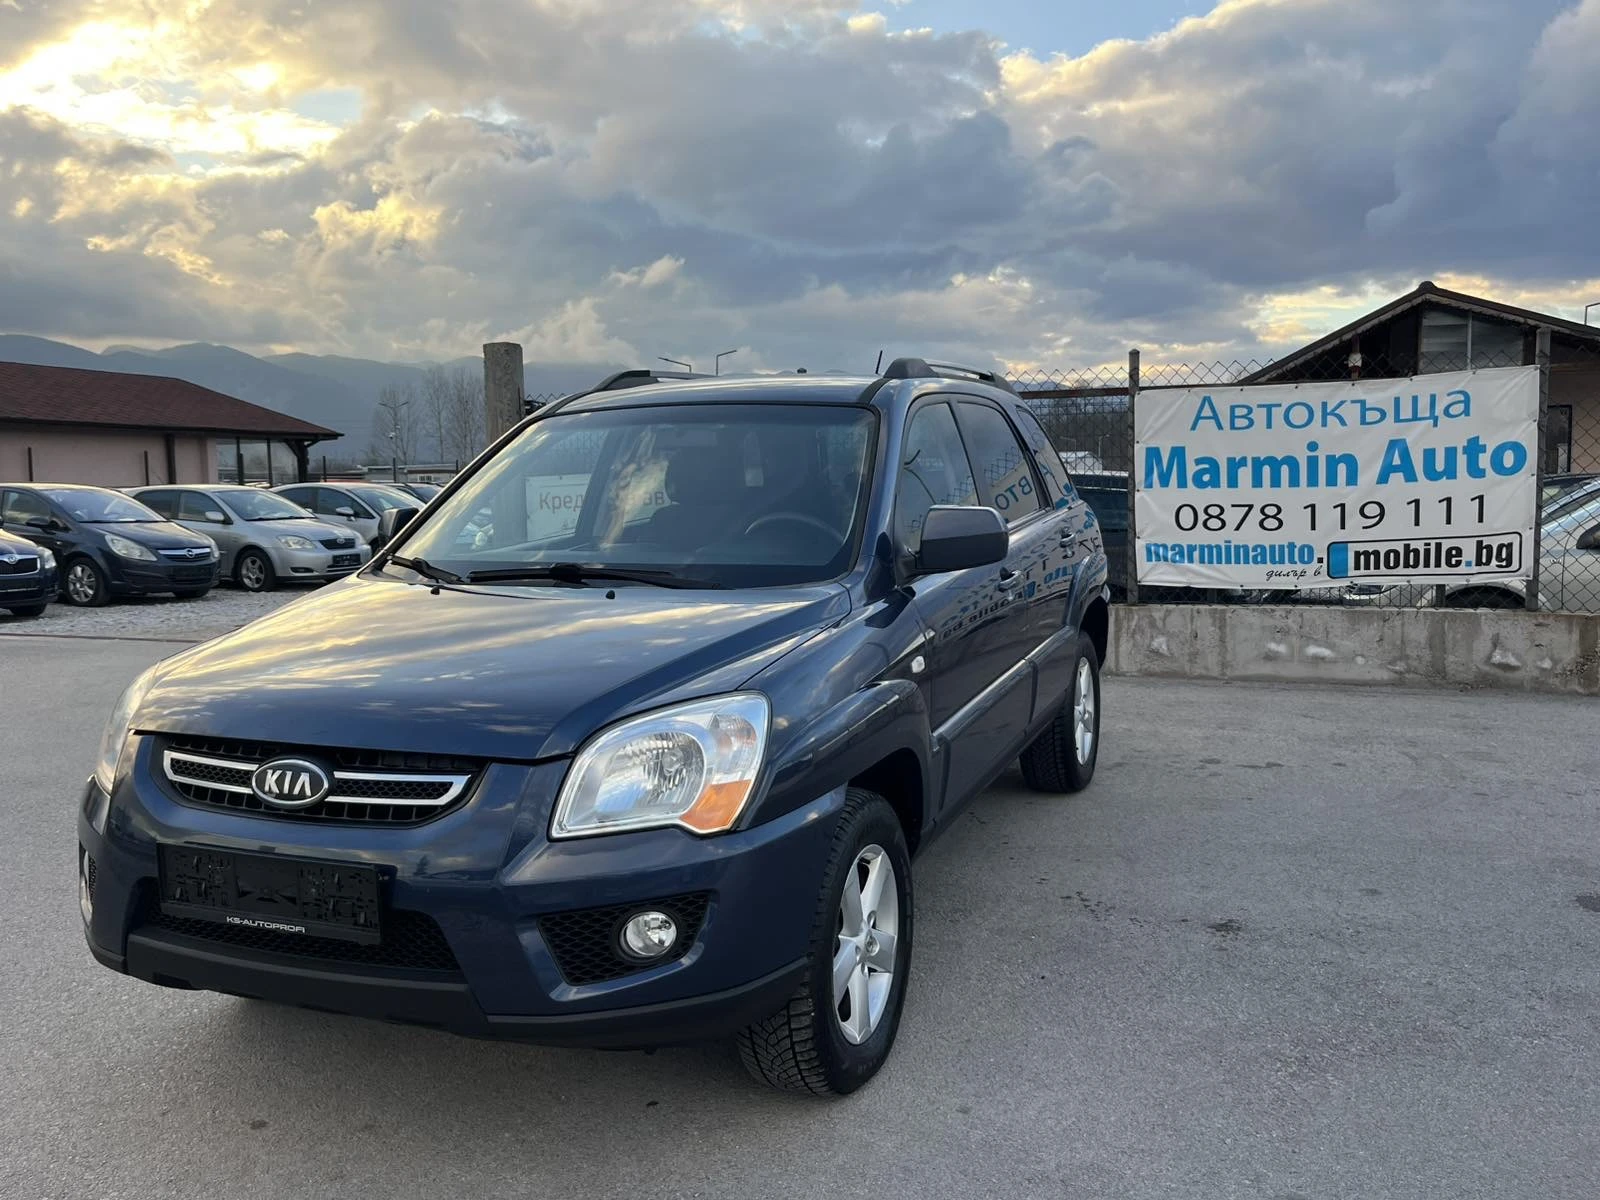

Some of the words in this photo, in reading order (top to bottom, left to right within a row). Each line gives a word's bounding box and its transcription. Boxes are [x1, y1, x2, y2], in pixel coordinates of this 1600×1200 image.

[1190, 388, 1472, 432] Автокъща
[1143, 440, 1359, 490] Marmin
[1375, 435, 1528, 486] Auto
[1174, 503, 1284, 532] 0878
[1303, 500, 1386, 531] 119
[1406, 494, 1486, 527] 111
[1353, 540, 1514, 573] mobile.bg
[264, 769, 312, 797] KIA
[226, 916, 306, 934] KS-AUTOPROFI
